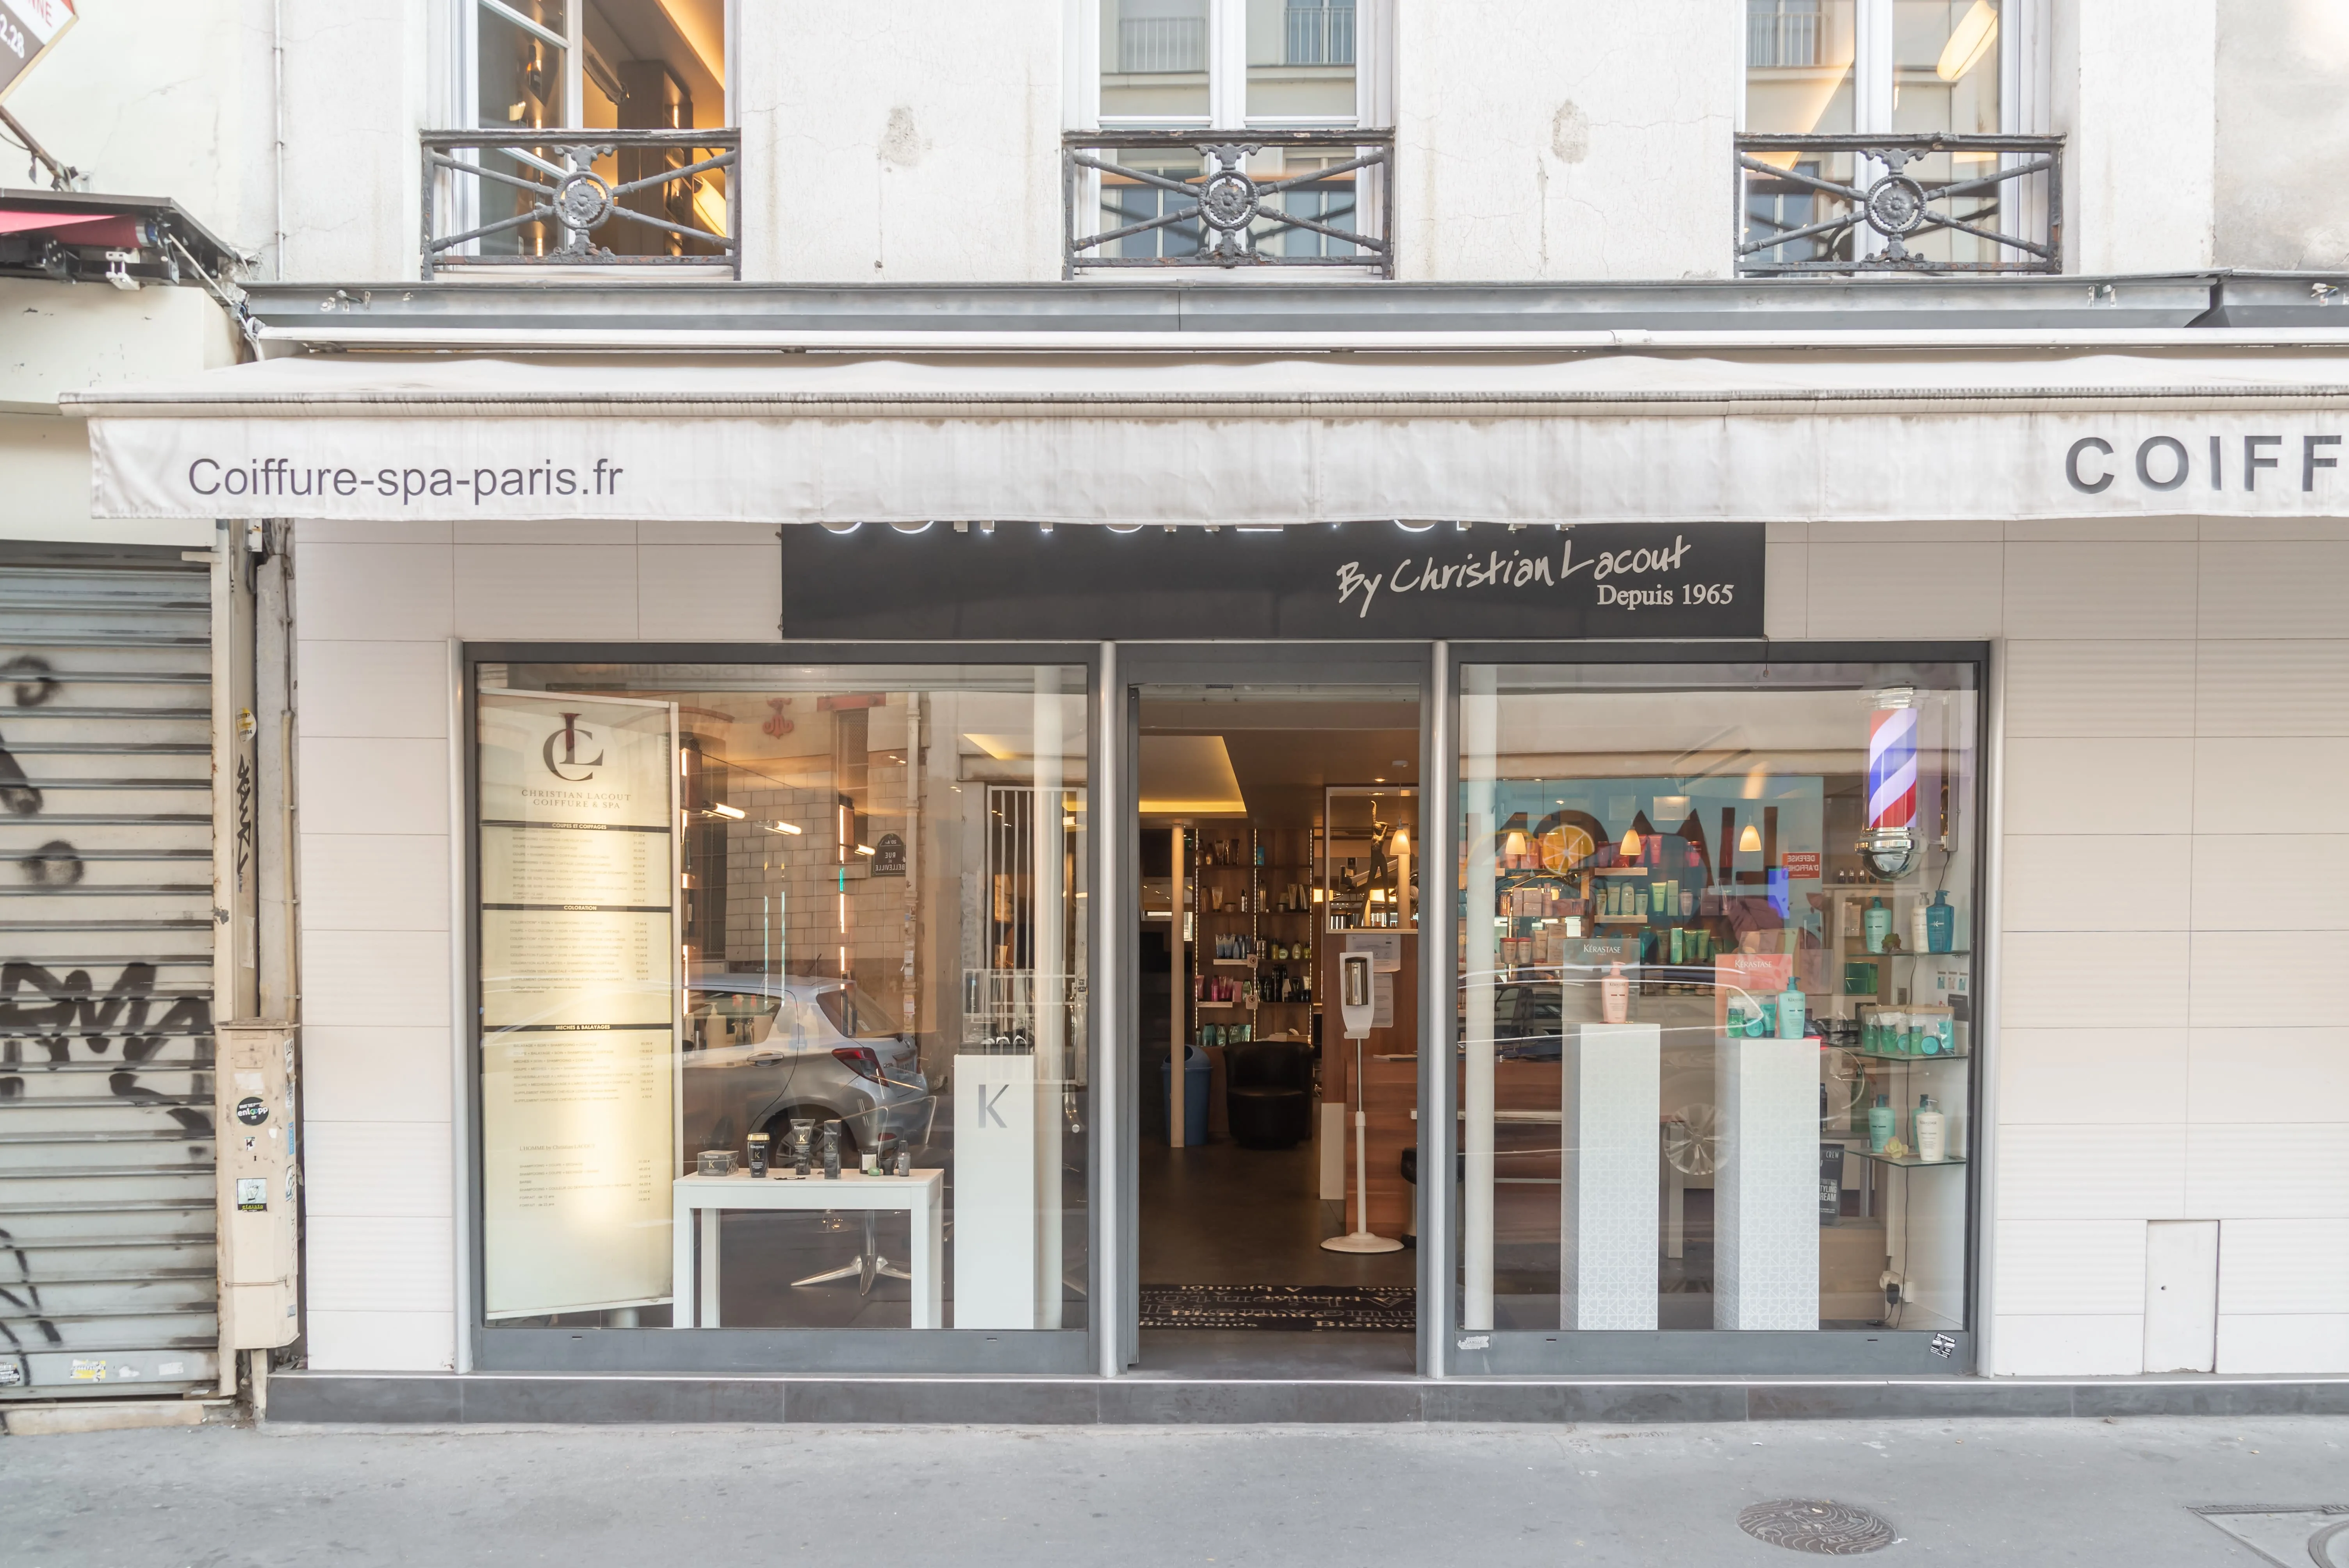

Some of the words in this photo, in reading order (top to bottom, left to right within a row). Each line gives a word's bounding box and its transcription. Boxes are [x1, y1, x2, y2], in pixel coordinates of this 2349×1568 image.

[2065, 435, 2342, 495] COIFF
[188, 458, 624, 506] Coiffure-spa-paris.fr
[1336, 561, 1383, 618] By
[1390, 550, 1555, 593] Christian
[1561, 535, 1691, 580] Lacout
[1597, 584, 1674, 610] Depuis
[1682, 583, 1735, 606] 1965
[522, 789, 583, 798] CHRISTIAN
[588, 792, 631, 801] LACOUT
[533, 799, 588, 807] COIFFURE
[1584, 944, 1621, 953] KÉRASTASE
[1735, 960, 1772, 968] KÉRASTASE
[978, 1084, 1010, 1128] K
[1820, 1185, 1837, 1193] TYLING
[1820, 1192, 1836, 1202] REAM
